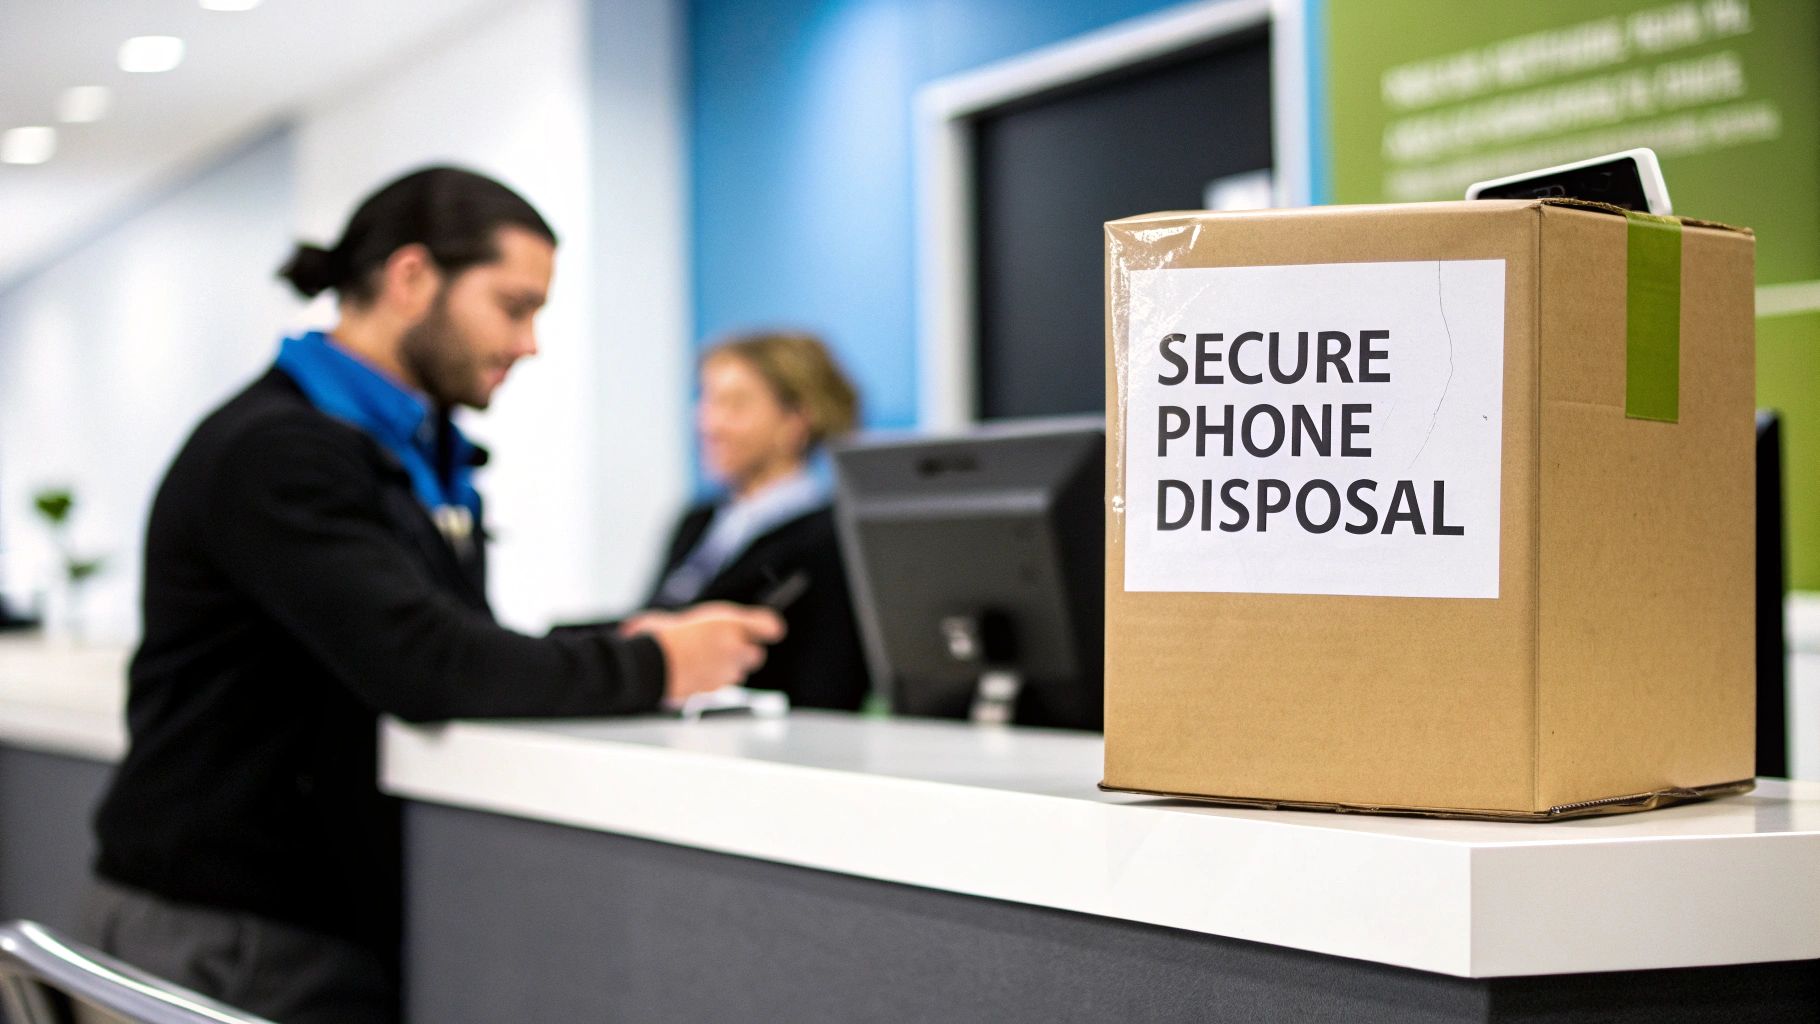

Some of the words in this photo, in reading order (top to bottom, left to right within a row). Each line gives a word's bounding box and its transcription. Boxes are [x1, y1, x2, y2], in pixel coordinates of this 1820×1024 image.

[1157, 329, 1391, 386] SECURE
[1157, 403, 1372, 458] PHONE
[1156, 478, 1465, 536] DISPOSAL
